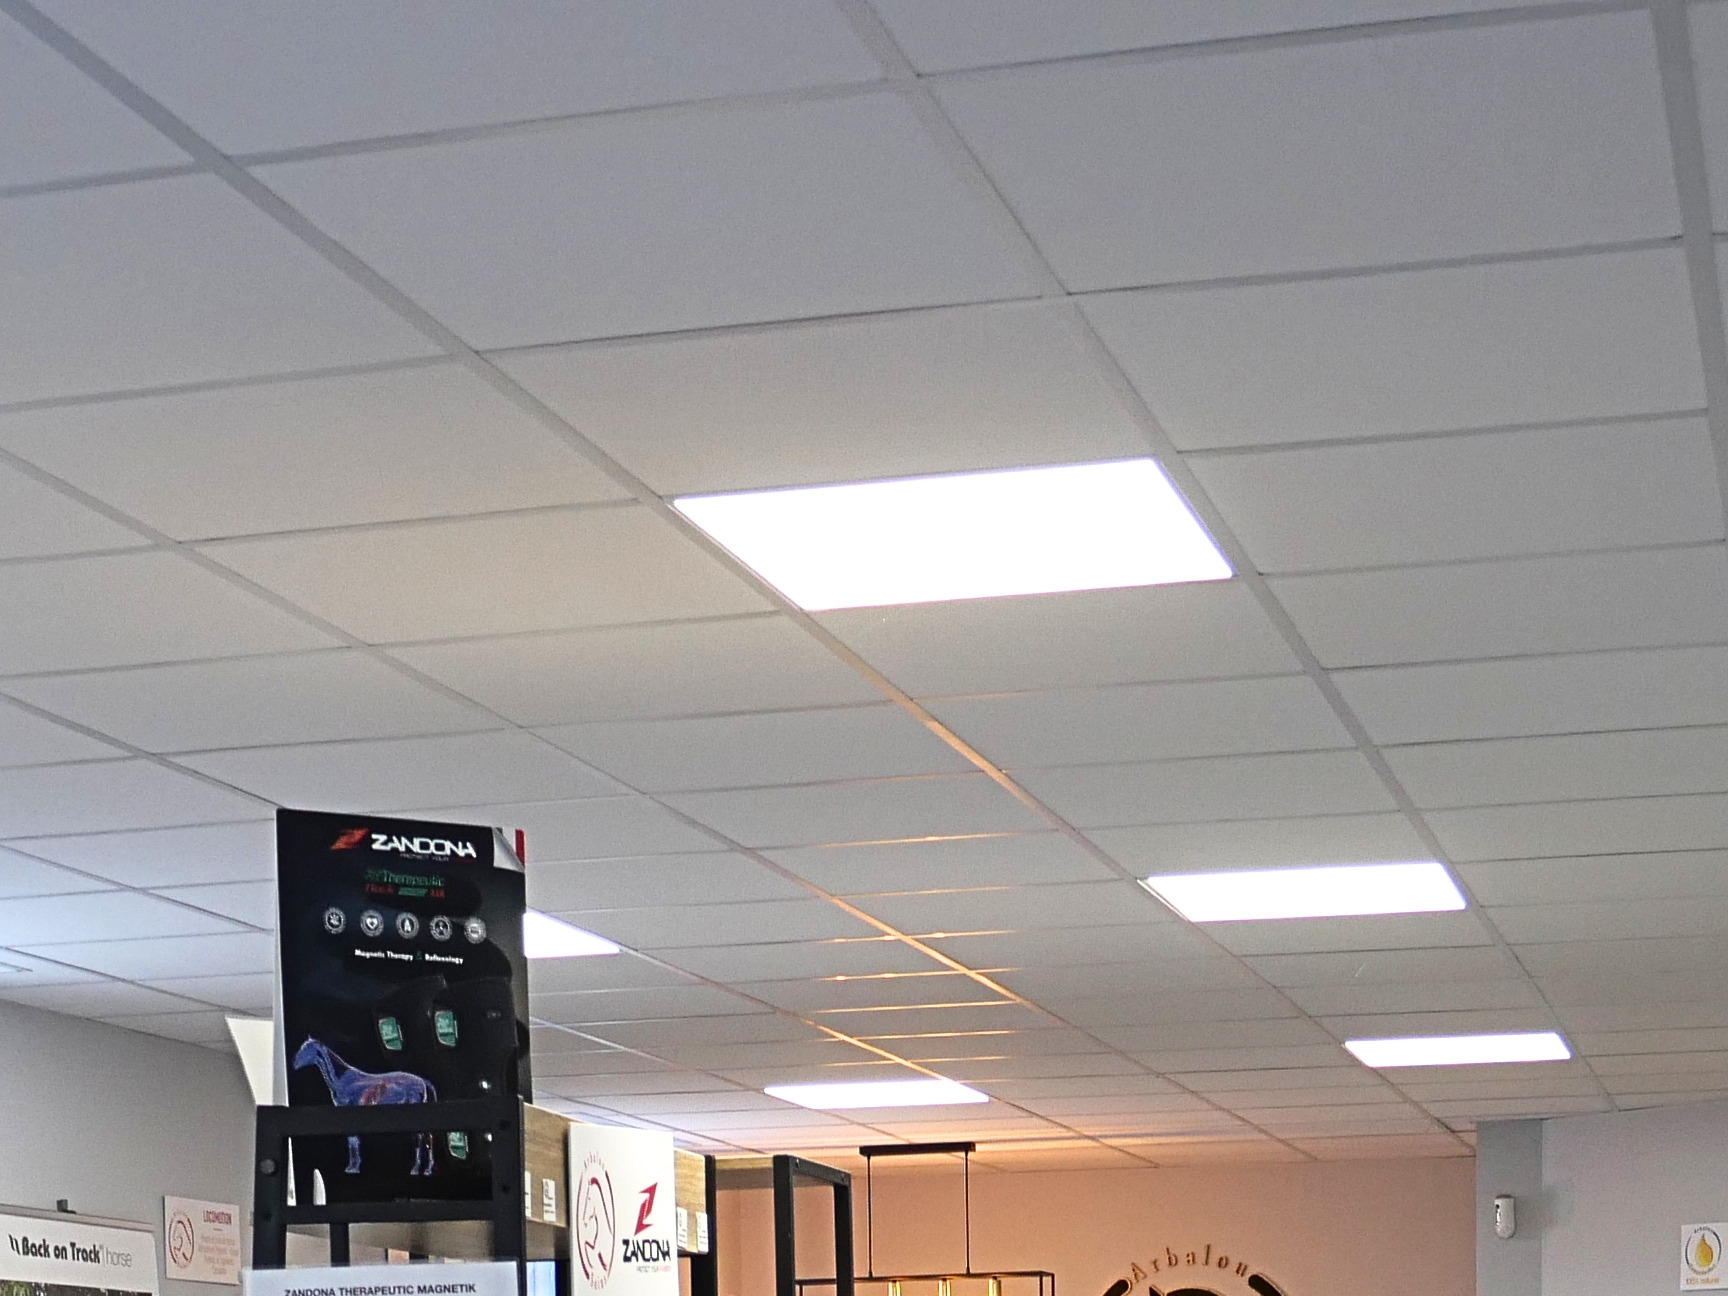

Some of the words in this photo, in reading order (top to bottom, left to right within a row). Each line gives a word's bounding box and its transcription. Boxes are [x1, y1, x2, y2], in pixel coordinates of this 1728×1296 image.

[372, 833, 477, 859] ZANDONA
[387, 950, 414, 962] Therapy
[22, 1235, 51, 1259] Back
[54, 1245, 68, 1261] on
[69, 1241, 101, 1264] Track
[105, 1245, 133, 1268] horse
[622, 1238, 672, 1263] ZANDONA
[1129, 1244, 1252, 1282] Arbalou
[417, 1283, 477, 1296] MAGNETIK
